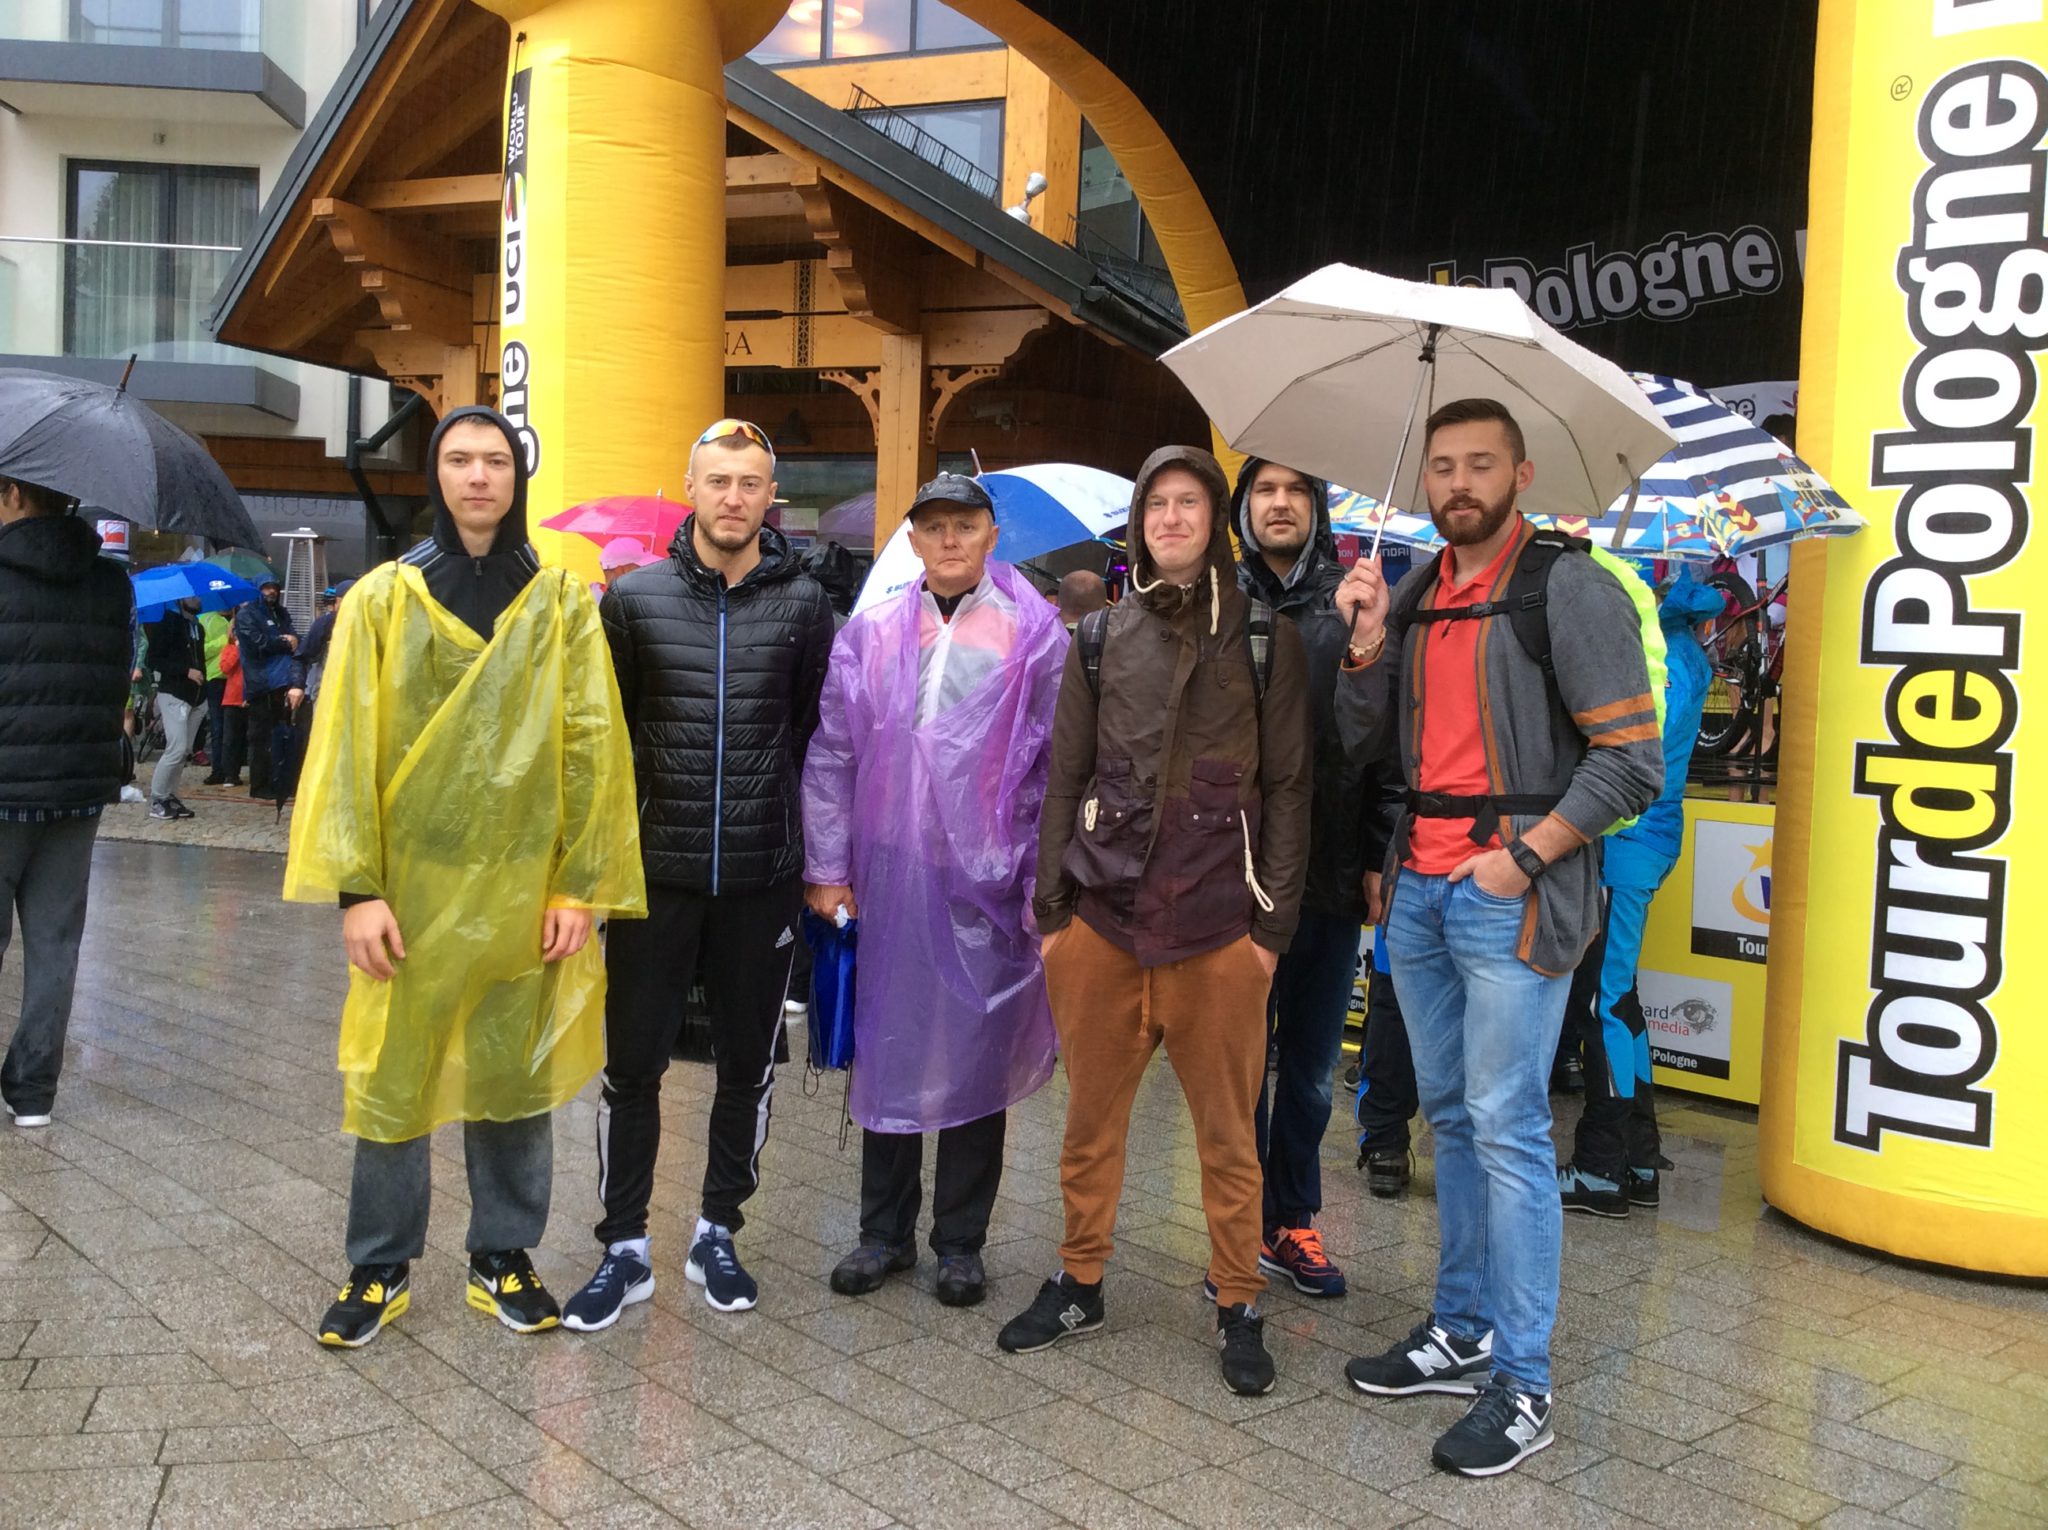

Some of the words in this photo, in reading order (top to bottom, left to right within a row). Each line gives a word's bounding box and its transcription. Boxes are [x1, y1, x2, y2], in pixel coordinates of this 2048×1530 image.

[515, 104, 526, 159] TOUR
[506, 230, 521, 315] UCI
[1429, 225, 1783, 330] Pologne
[1360, 547, 1411, 558] HYNDAI
[1737, 937, 1768, 957] Tou
[1648, 1020, 1690, 1036] media
[1650, 1048, 1698, 1068] Pologne
